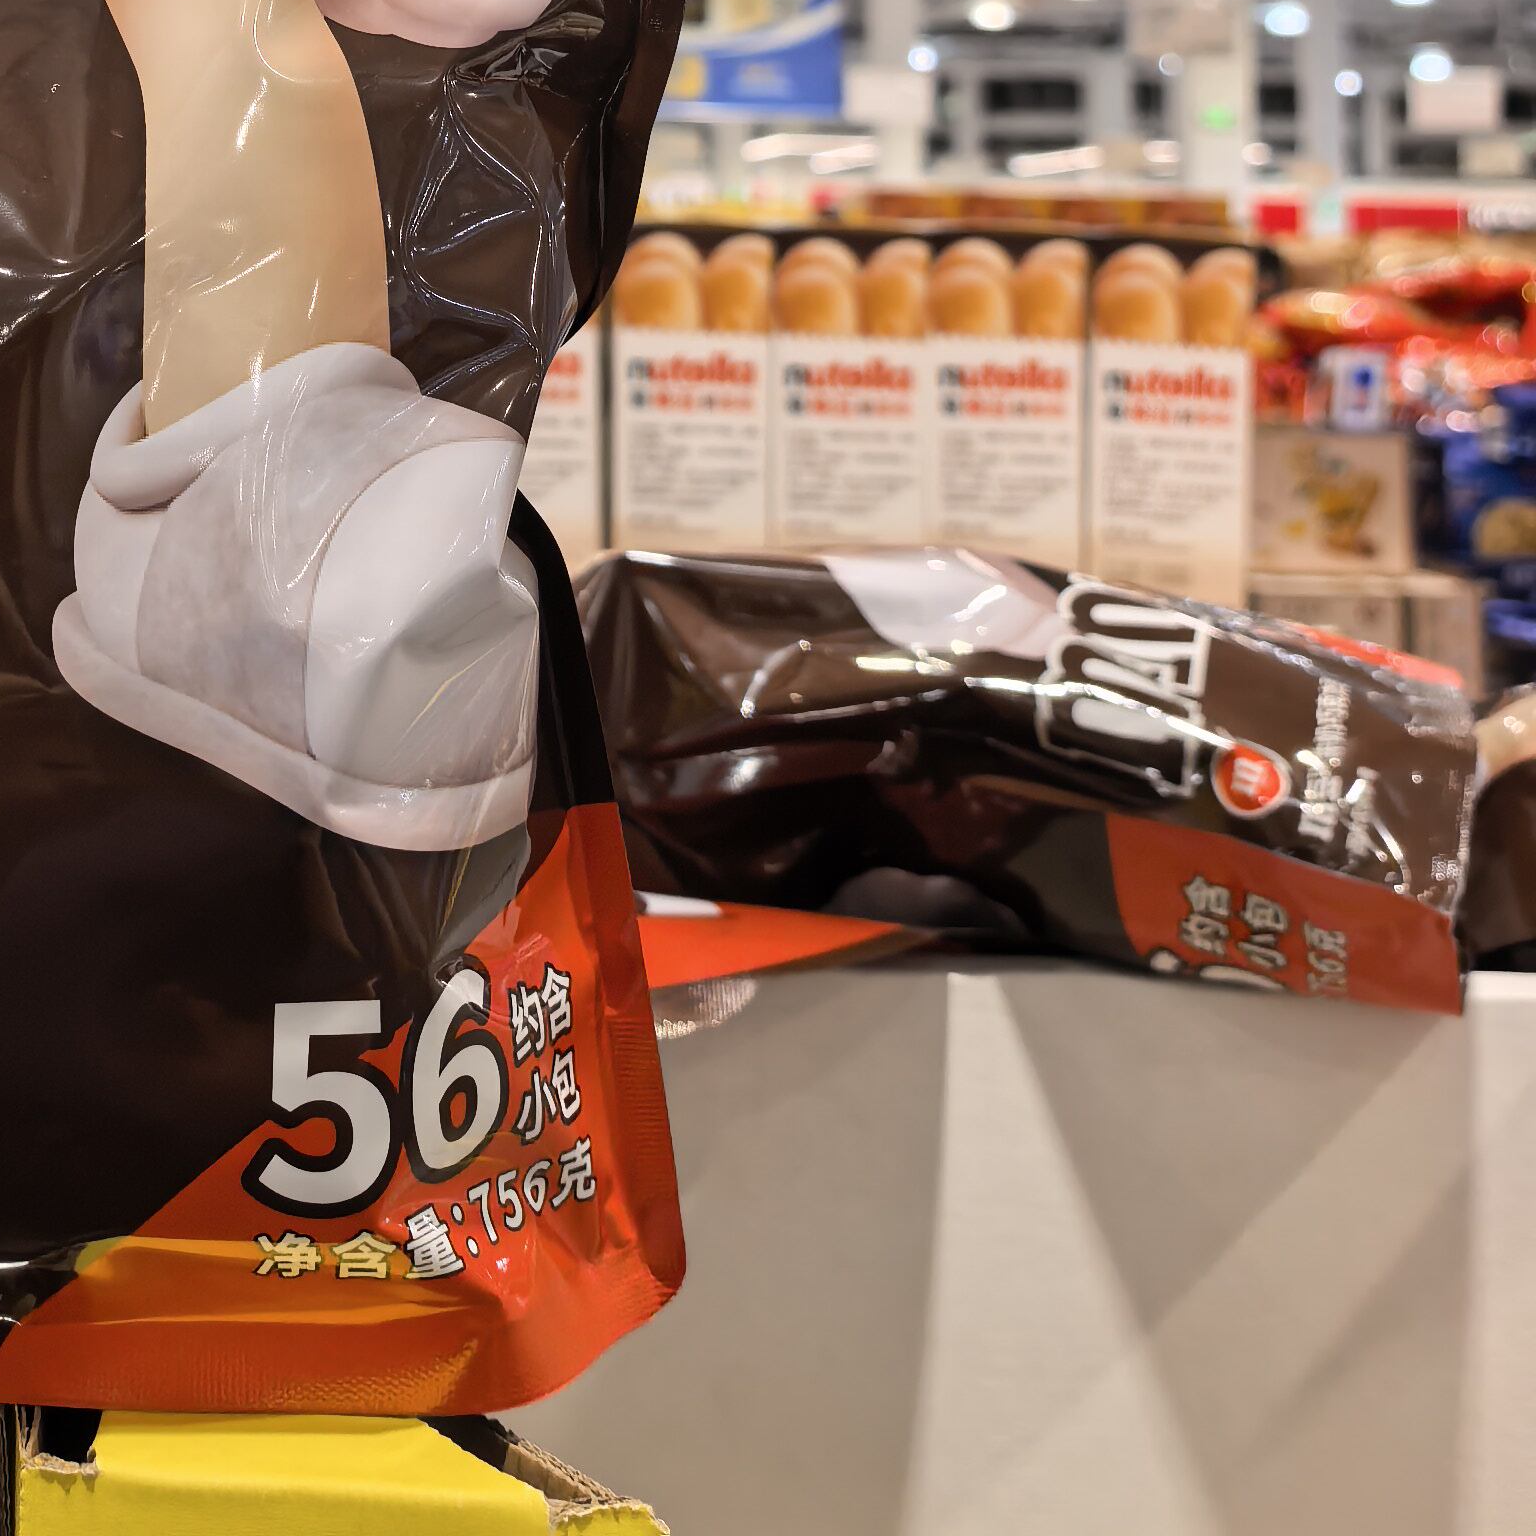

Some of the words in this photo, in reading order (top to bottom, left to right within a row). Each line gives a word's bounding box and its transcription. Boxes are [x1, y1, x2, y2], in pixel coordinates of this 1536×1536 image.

[511, 966, 571, 1061] 约含
[257, 967, 502, 1206] 56
[516, 1052, 582, 1141] 小包
